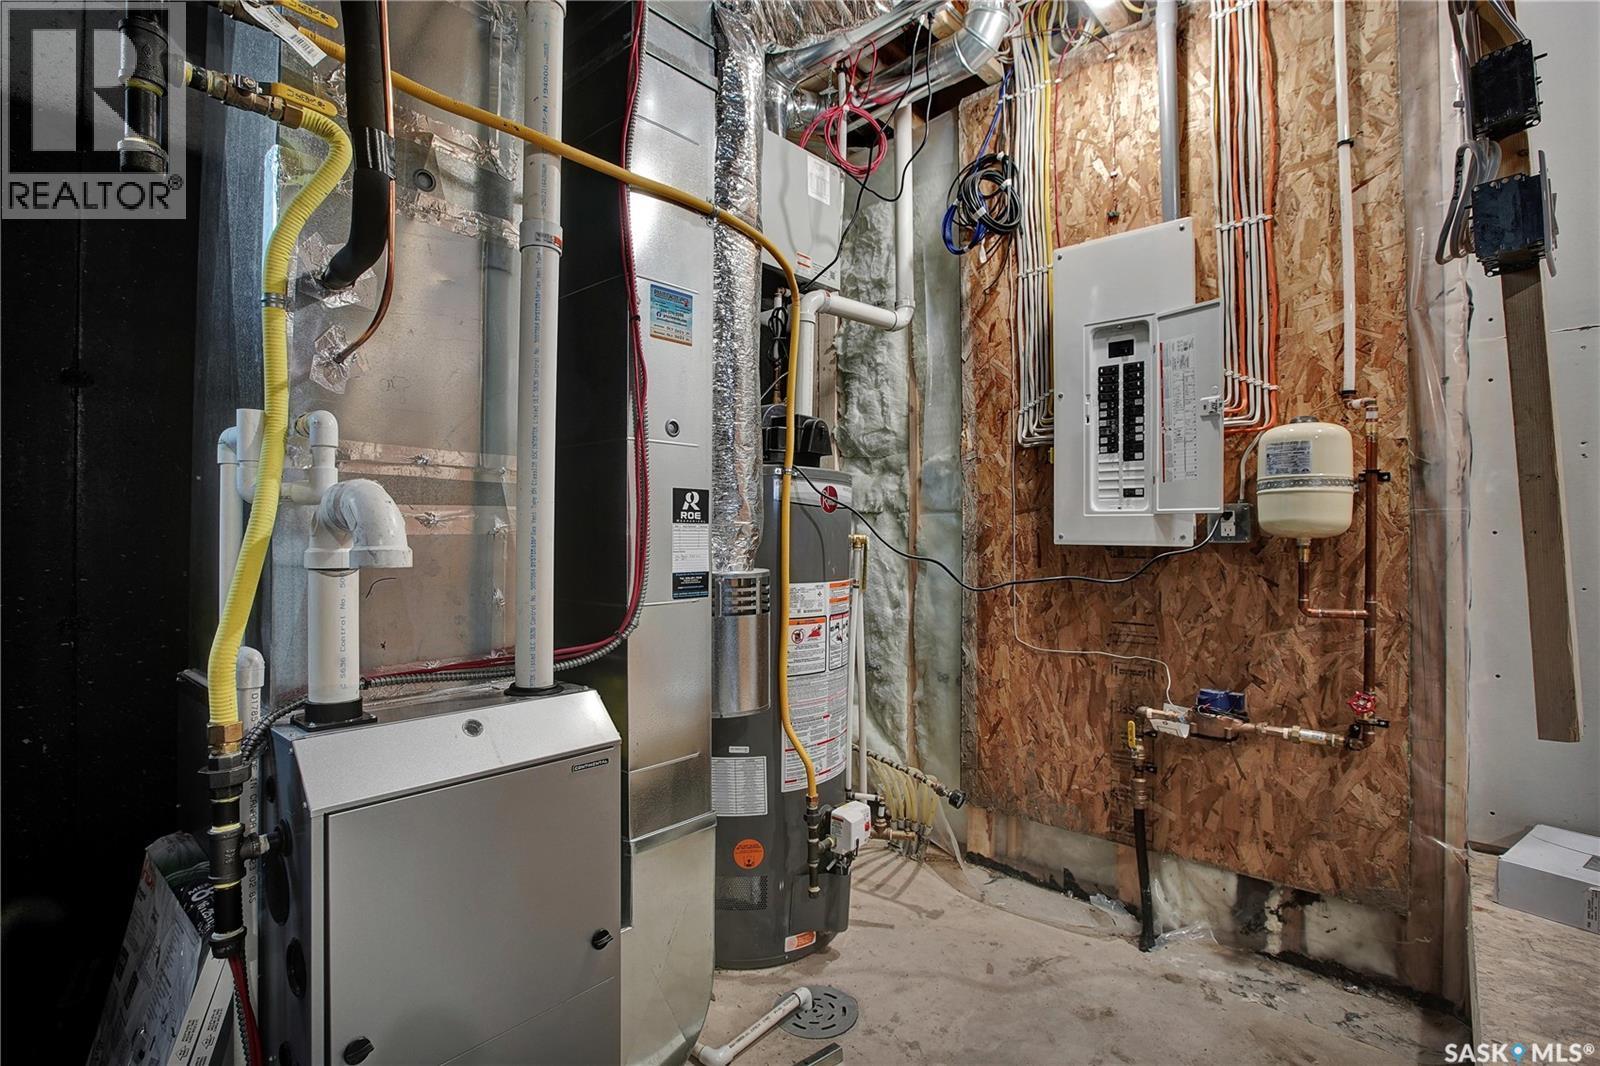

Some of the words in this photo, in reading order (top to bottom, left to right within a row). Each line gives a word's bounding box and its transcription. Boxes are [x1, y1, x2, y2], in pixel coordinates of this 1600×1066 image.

[680, 511, 702, 520] ROE
[250, 692, 259, 722] D1785
[574, 760, 609, 771] CONTINENTAL
[249, 794, 258, 829] CANADA
